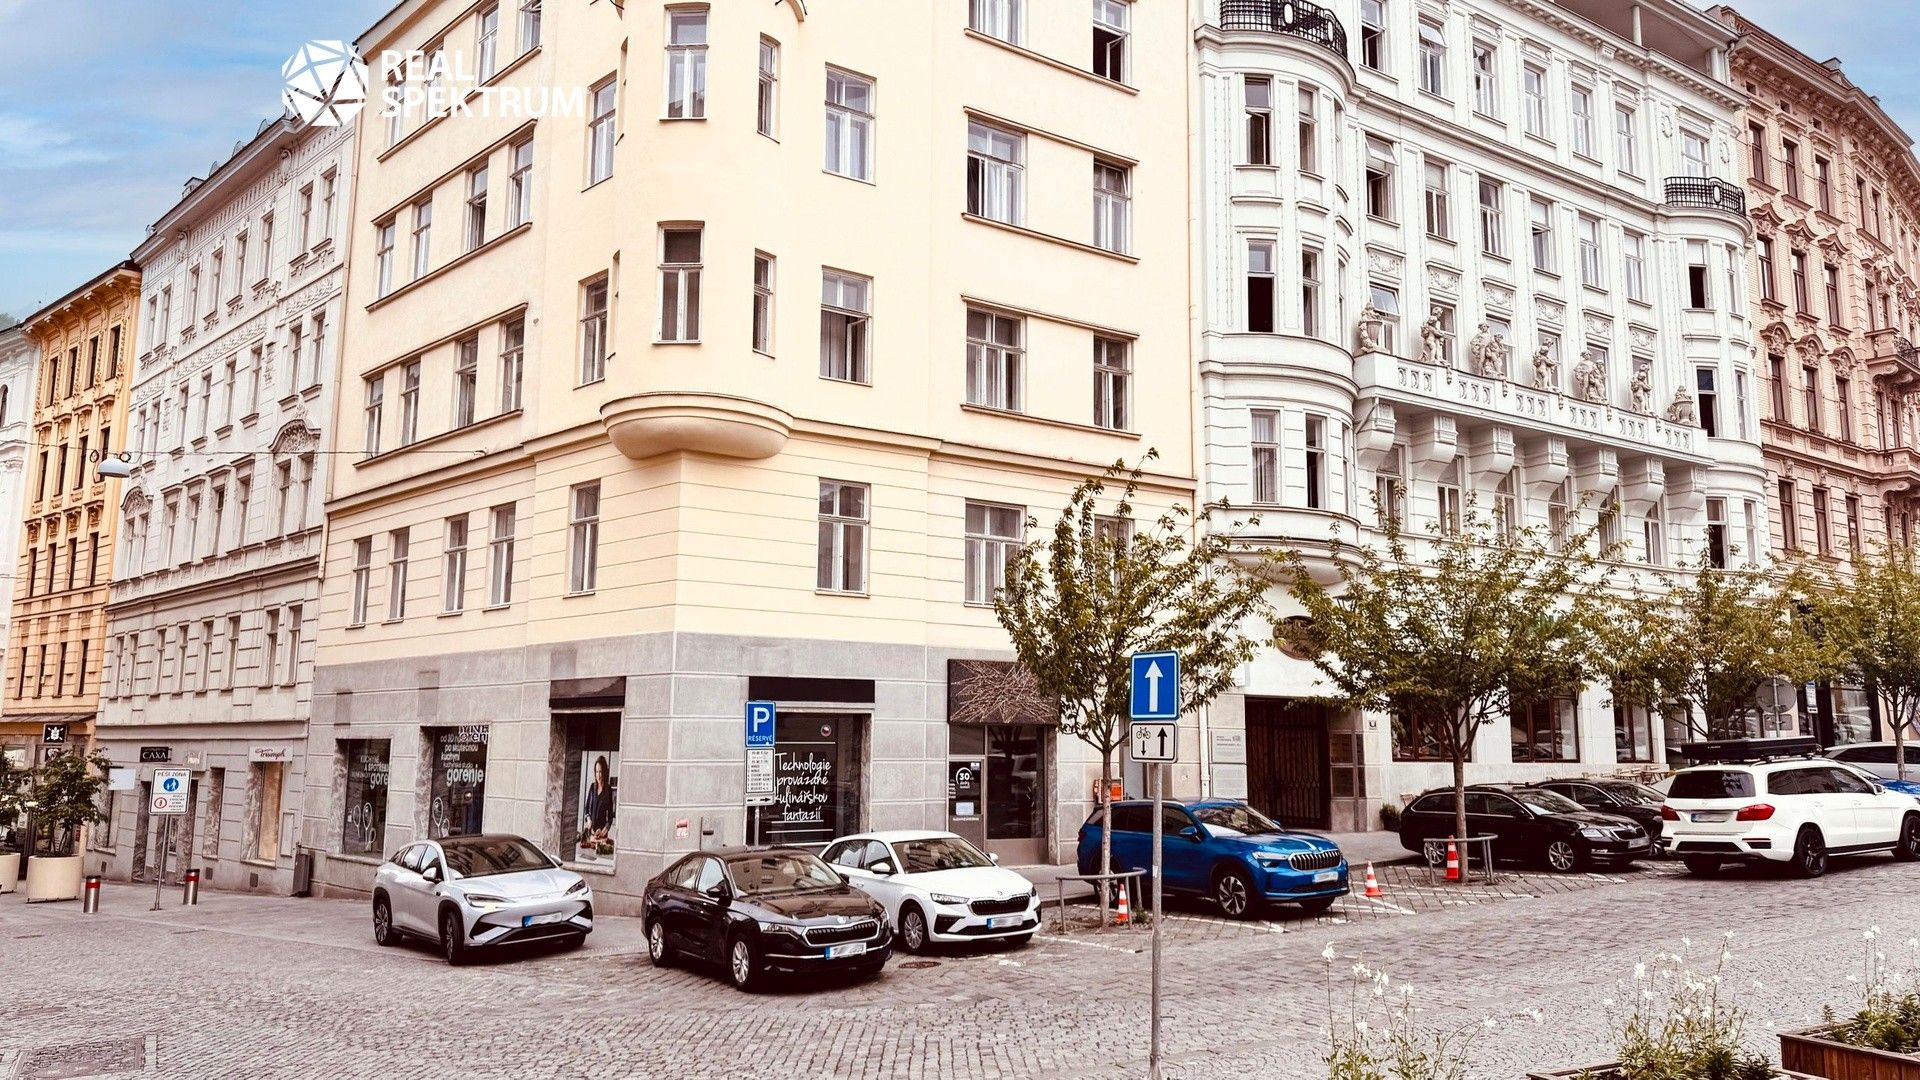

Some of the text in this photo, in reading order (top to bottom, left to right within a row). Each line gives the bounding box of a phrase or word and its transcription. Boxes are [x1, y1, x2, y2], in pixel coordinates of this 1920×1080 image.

[753, 707, 770, 733] P
[748, 734, 773, 742] RÉSERVÉ
[255, 748, 286, 760] Triumph
[775, 751, 831, 777] Technologie
[370, 772, 388, 790] gore
[446, 763, 484, 787] gorenje
[959, 772, 970, 781] 30
[782, 803, 822, 821] fantazií
